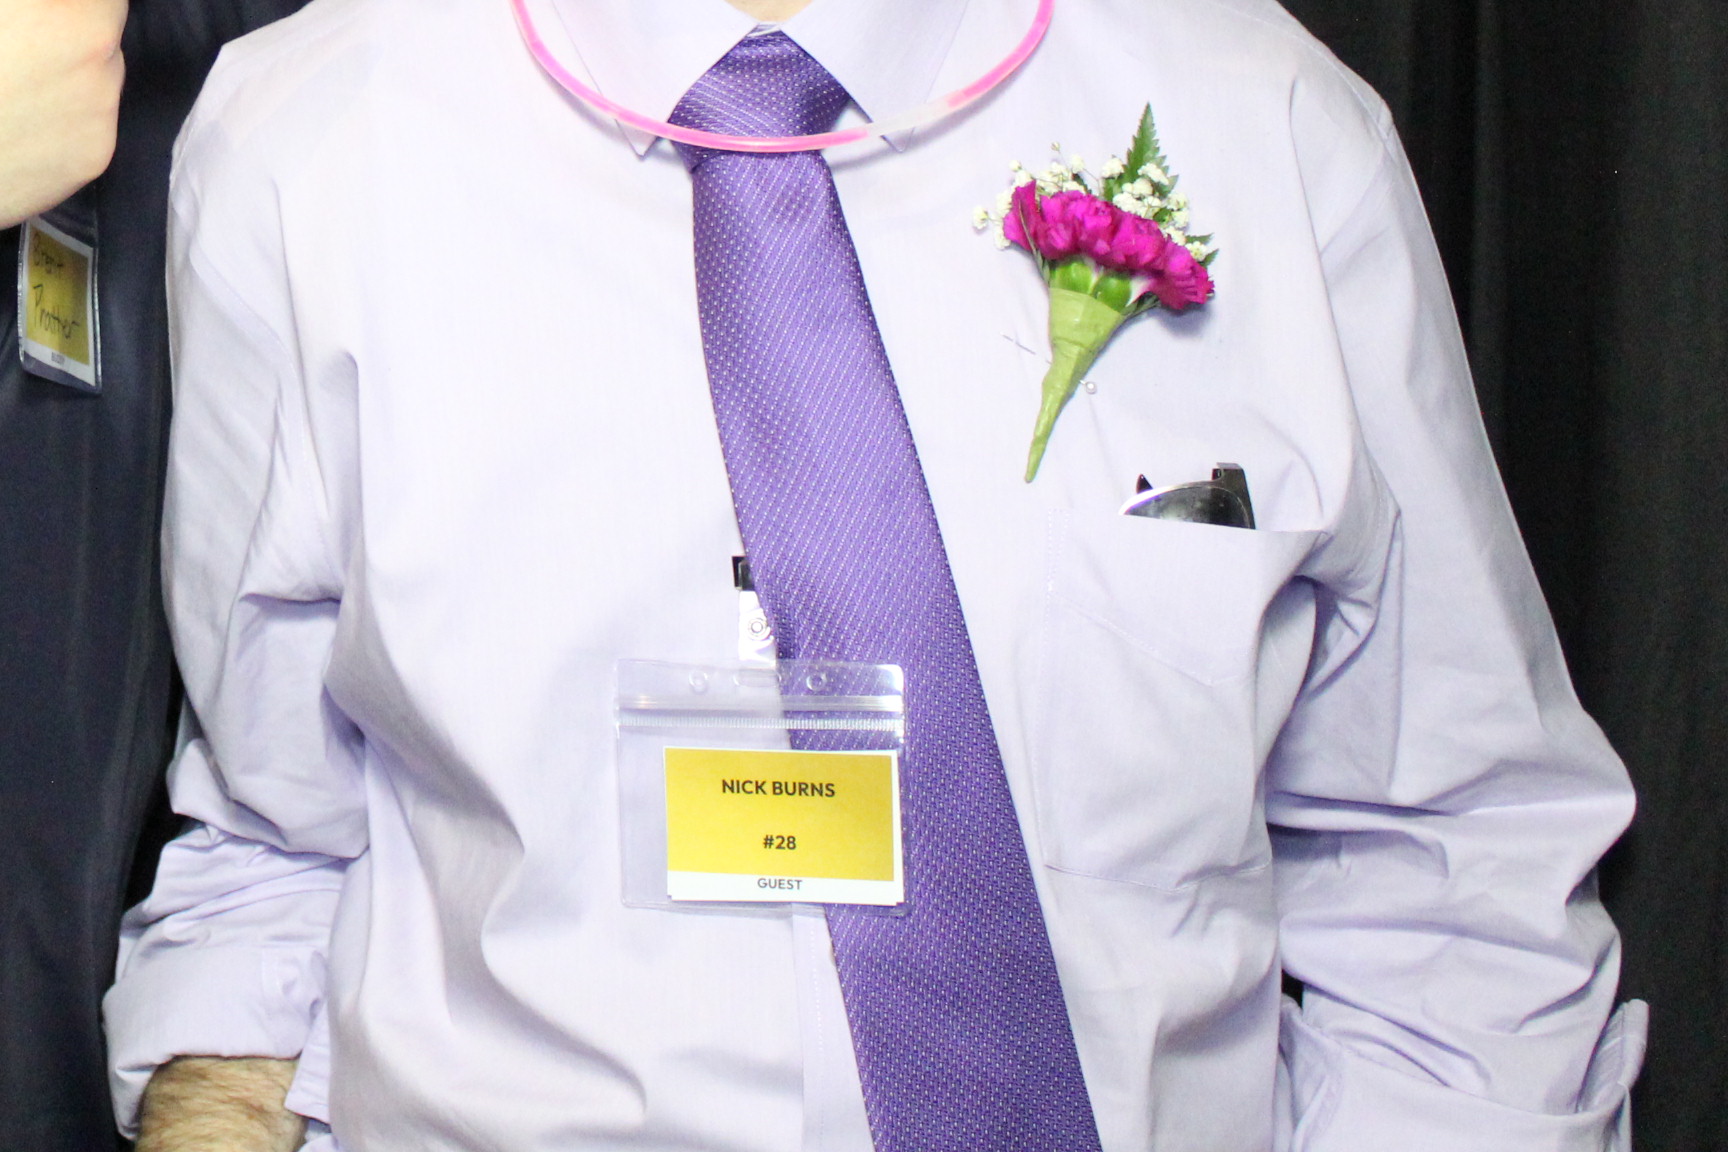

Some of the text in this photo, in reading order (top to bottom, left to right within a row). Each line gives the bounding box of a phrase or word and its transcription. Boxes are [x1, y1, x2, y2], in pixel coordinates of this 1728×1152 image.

[721, 779, 836, 798] NICK BURNS
[763, 834, 797, 850] #28
[757, 877, 803, 890] GUEST
